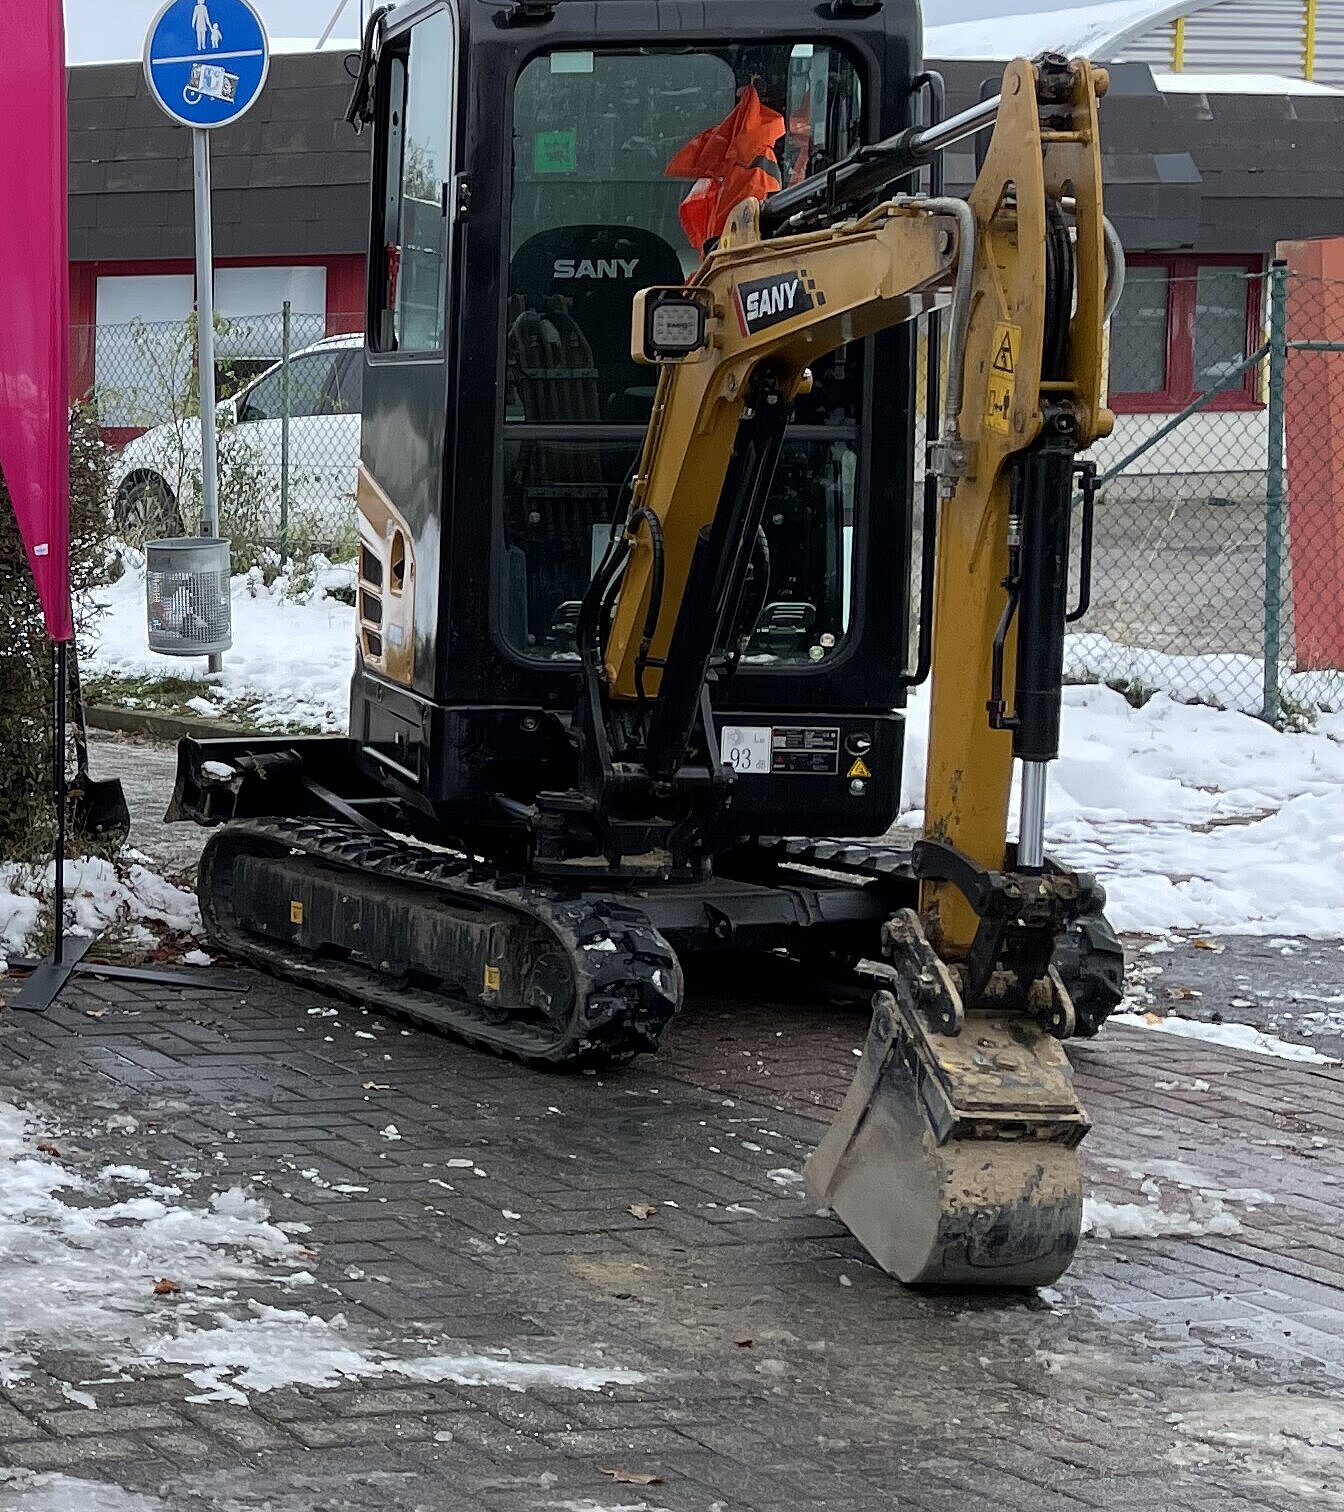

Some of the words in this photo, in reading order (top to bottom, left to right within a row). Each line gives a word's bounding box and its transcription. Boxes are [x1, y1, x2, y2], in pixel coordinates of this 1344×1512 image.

[553, 258, 640, 278] SANY
[746, 278, 799, 321] SANY
[729, 747, 752, 769] 93
